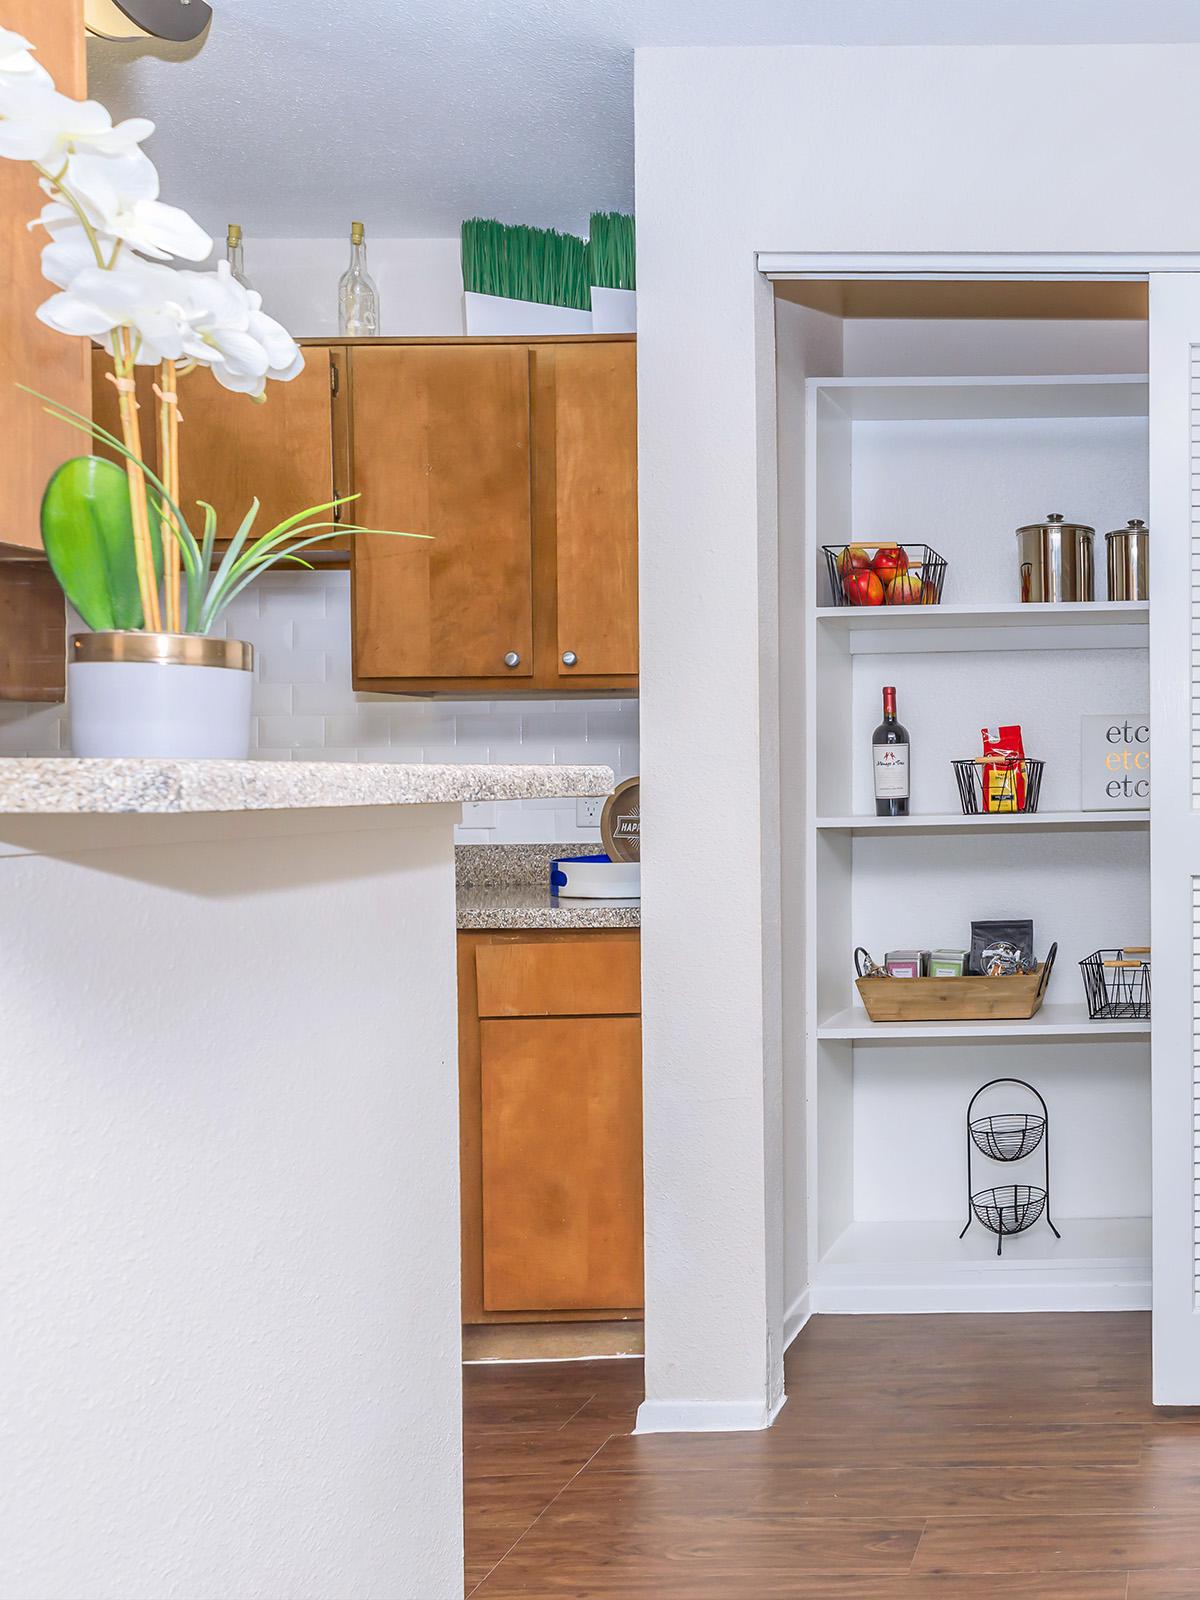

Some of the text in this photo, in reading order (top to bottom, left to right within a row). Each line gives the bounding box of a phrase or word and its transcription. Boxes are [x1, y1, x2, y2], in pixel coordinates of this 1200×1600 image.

[1106, 720, 1150, 744] etc
[1104, 747, 1150, 772] etc
[1106, 774, 1150, 798] etc
